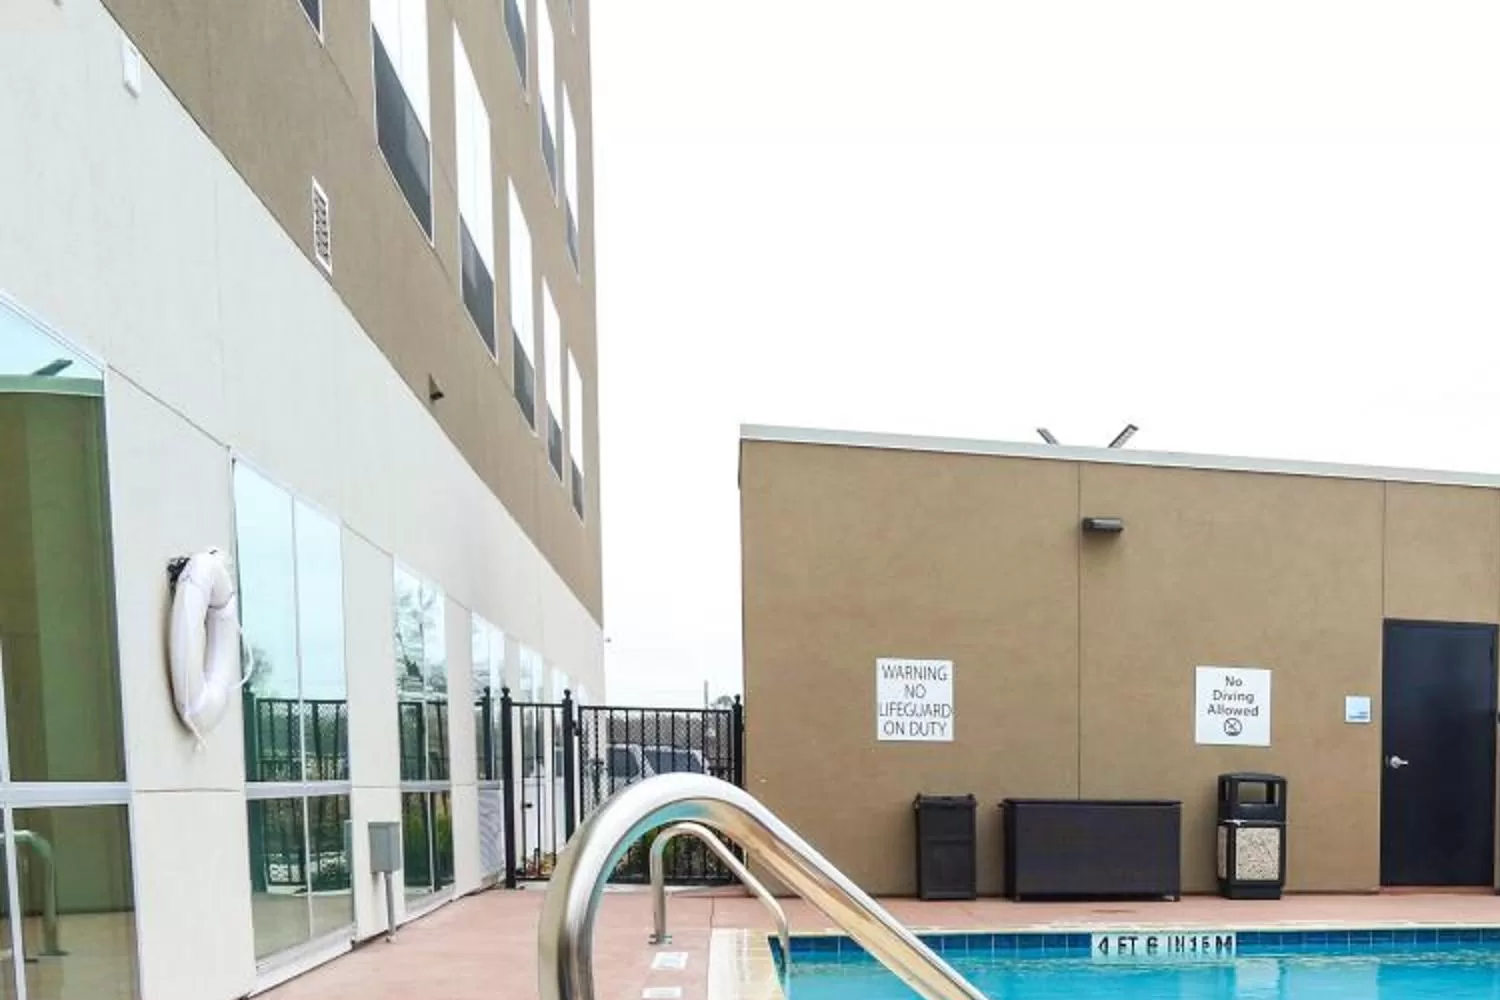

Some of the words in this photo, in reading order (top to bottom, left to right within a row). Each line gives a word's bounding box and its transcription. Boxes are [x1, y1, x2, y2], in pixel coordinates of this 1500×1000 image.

[881, 664, 948, 681] WARNING
[1225, 676, 1243, 687] No
[904, 683, 927, 699] NO
[1213, 689, 1255, 704] Diving
[880, 701, 952, 719] LIFEGUARD
[1207, 704, 1259, 717] Allowed
[883, 720, 905, 736] ON
[909, 721, 947, 736] DUTY
[1117, 936, 1138, 952] FT
[1168, 936, 1185, 952] IN
[1215, 936, 1233, 951] M
